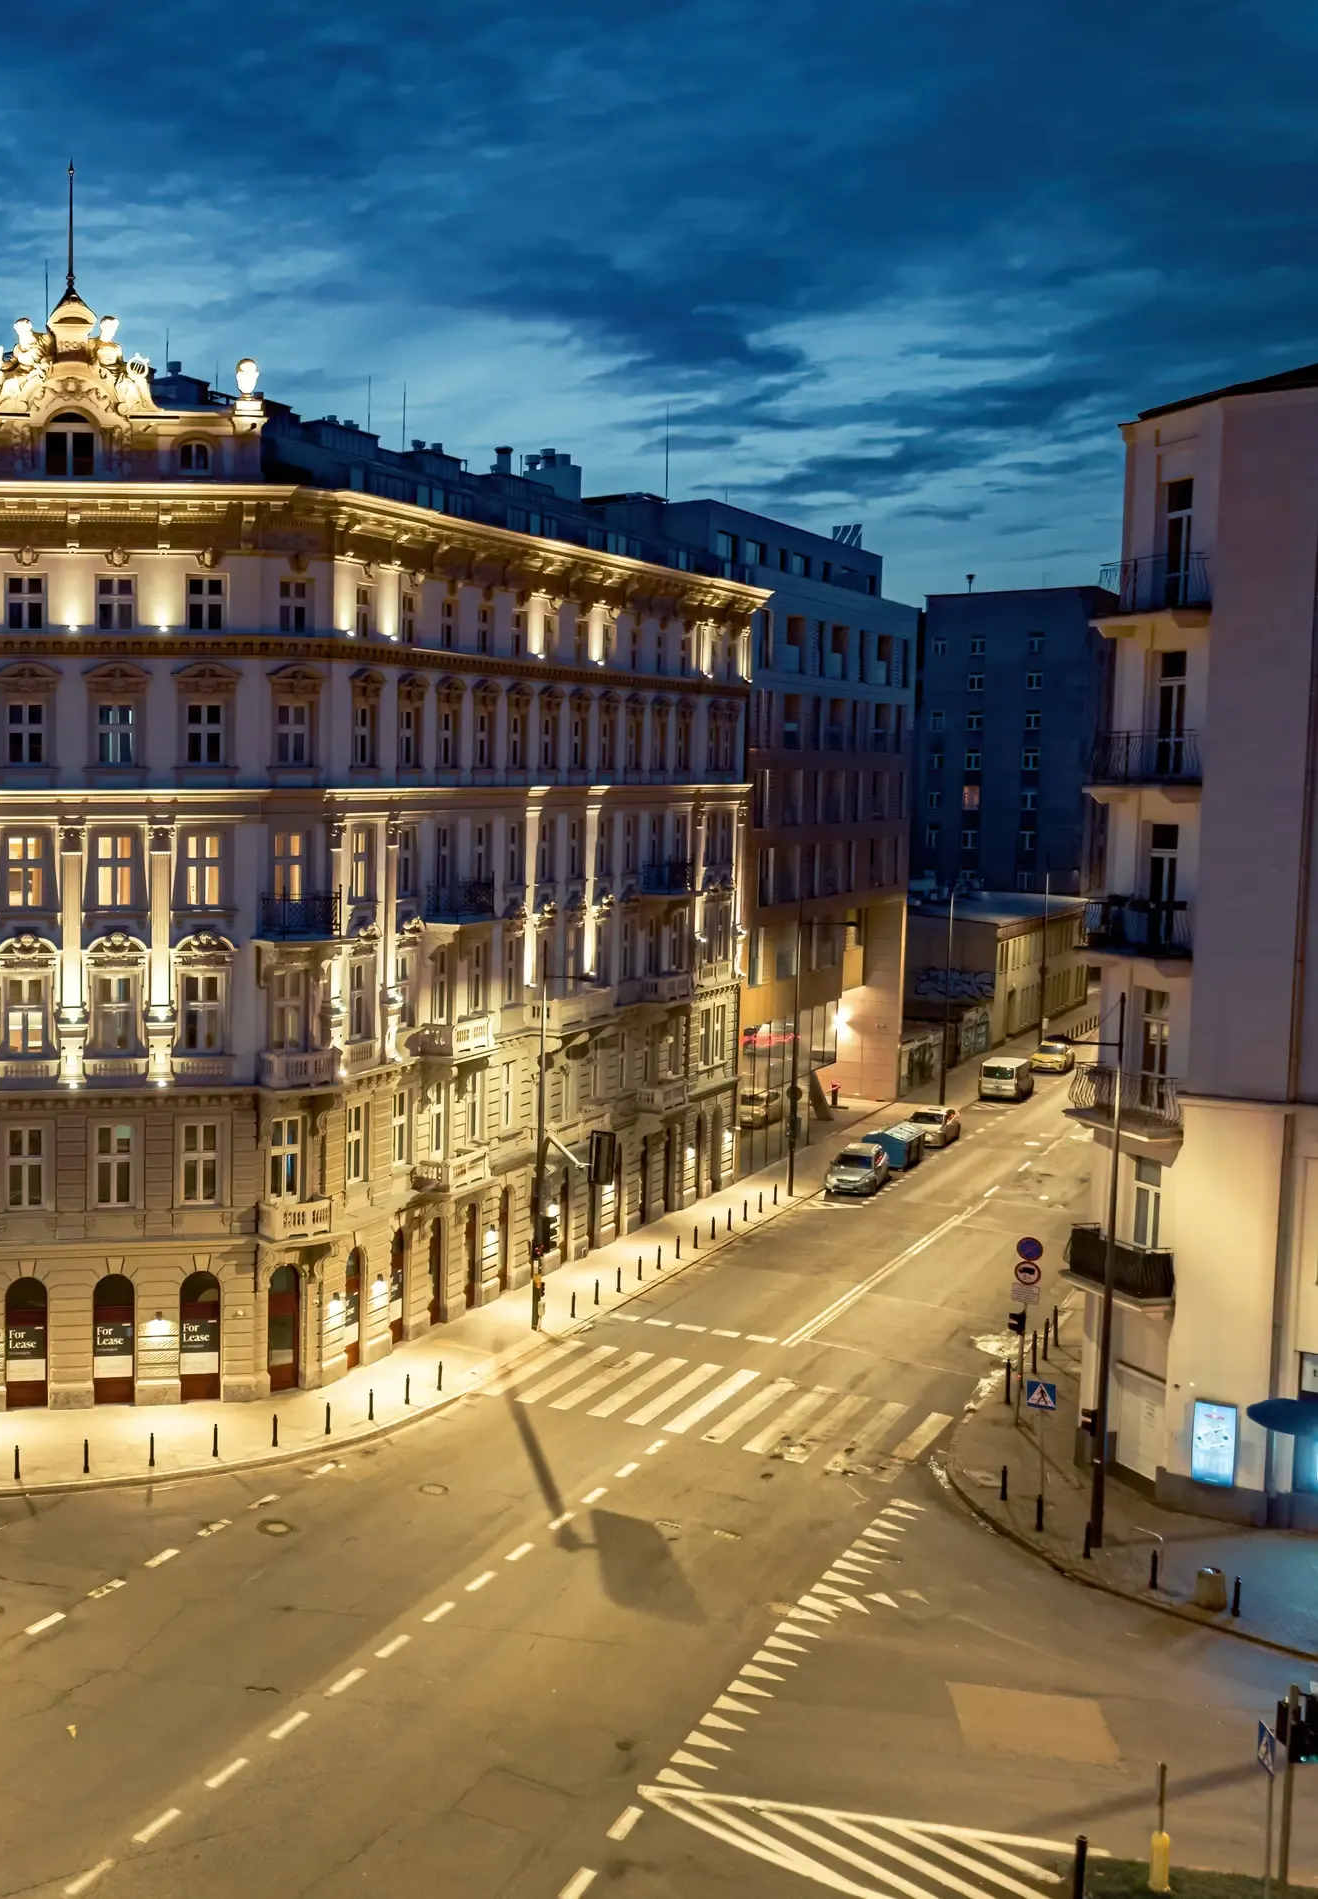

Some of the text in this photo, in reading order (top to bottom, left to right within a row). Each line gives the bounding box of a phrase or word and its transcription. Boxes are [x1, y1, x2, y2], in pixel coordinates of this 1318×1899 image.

[96, 1326, 114, 1336] For
[182, 1323, 200, 1332] For
[8, 1329, 26, 1339] For
[182, 1333, 210, 1342] Lease
[8, 1339, 37, 1349] Lease
[96, 1336, 124, 1346] Lease
